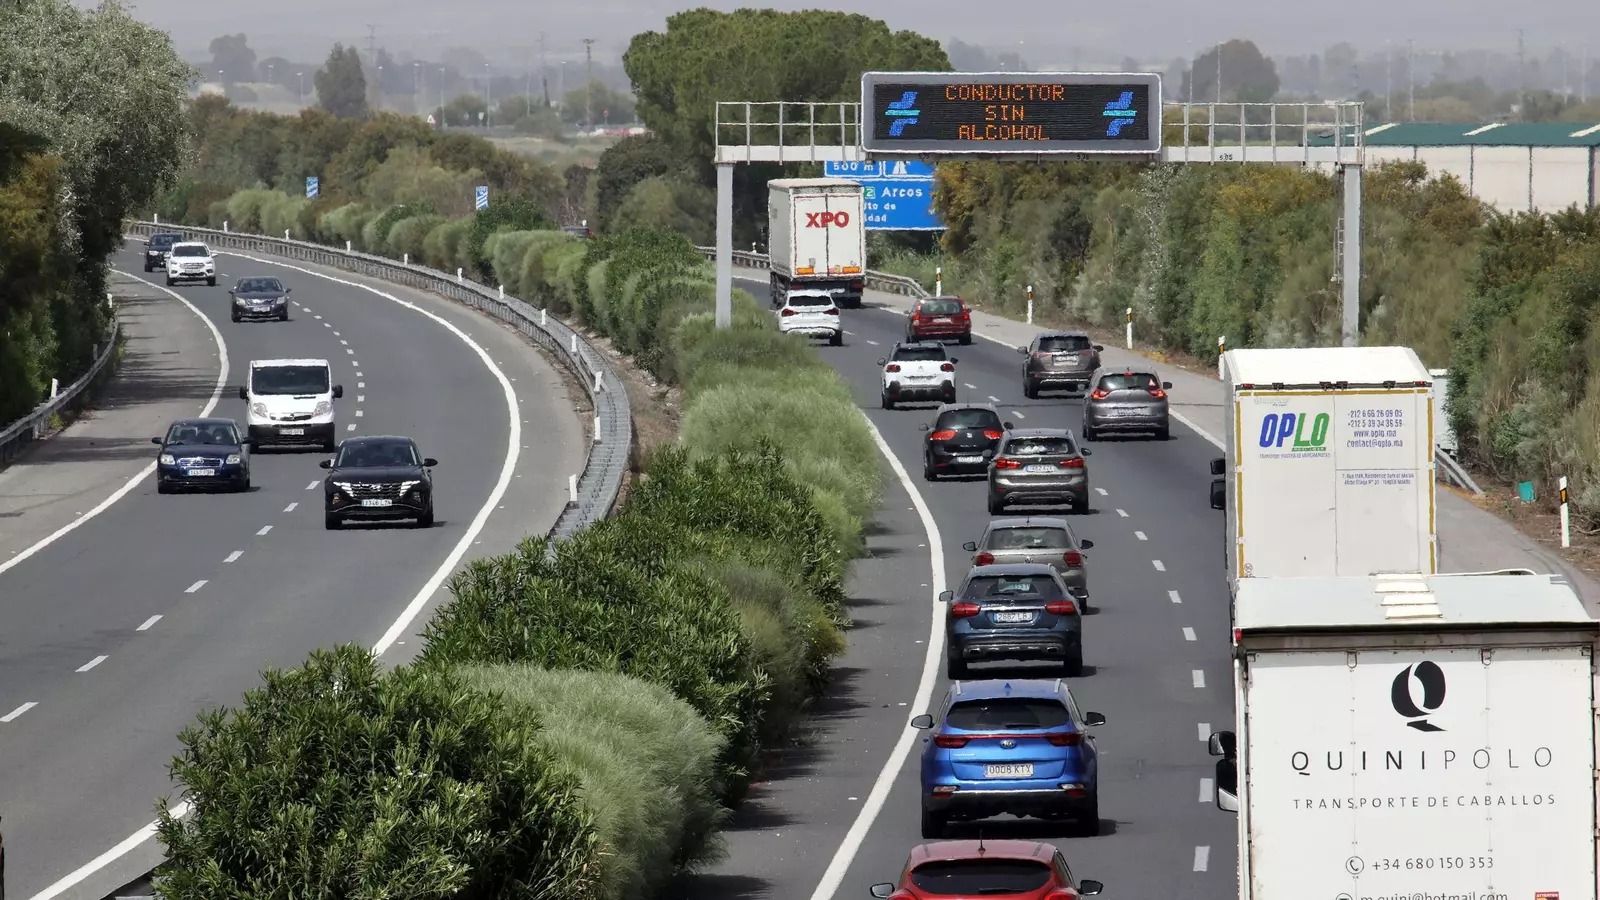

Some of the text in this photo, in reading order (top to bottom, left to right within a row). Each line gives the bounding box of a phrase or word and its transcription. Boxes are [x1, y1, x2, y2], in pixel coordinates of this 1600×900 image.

[945, 84, 1065, 101] CONDUCTOR
[985, 105, 1024, 121] SIN
[958, 125, 1049, 141] ALCOHOL
[881, 186, 924, 198] Arcos
[883, 202, 896, 210] de
[806, 211, 850, 229] XPO
[1259, 412, 1330, 448] OPLO
[988, 763, 1032, 774] 0008 KTX
[1291, 746, 1552, 775] QUINIPOLO
[1294, 794, 1555, 809] TRANSPORTE DE CABALLOS
[1372, 856, 1494, 870] +34 680 150 353
